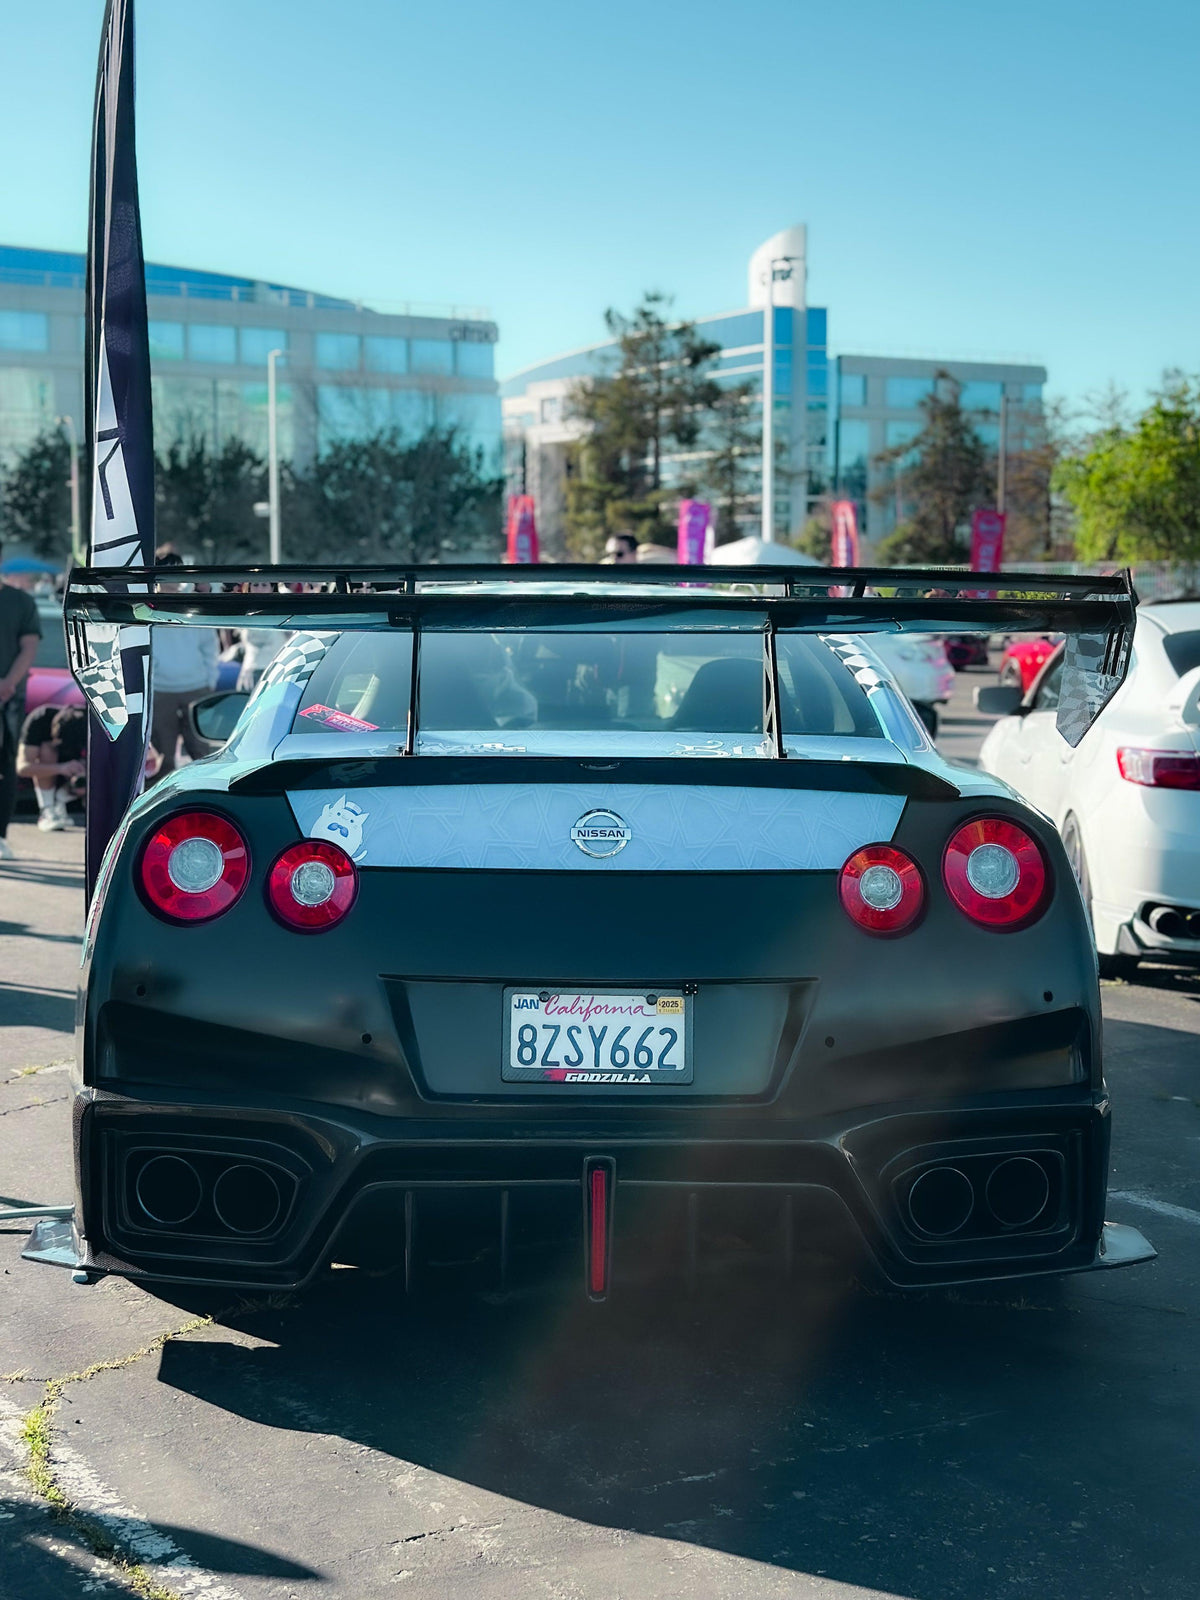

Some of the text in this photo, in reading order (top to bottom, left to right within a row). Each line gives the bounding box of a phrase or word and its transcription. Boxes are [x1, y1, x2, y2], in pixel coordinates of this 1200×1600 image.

[577, 829, 625, 838] NISSAN
[514, 999, 539, 1009] JAN
[545, 994, 656, 1022] California
[661, 1000, 679, 1009] 2025
[517, 1024, 678, 1070] 8ZSY662
[565, 1073, 651, 1083] GODZILLA
